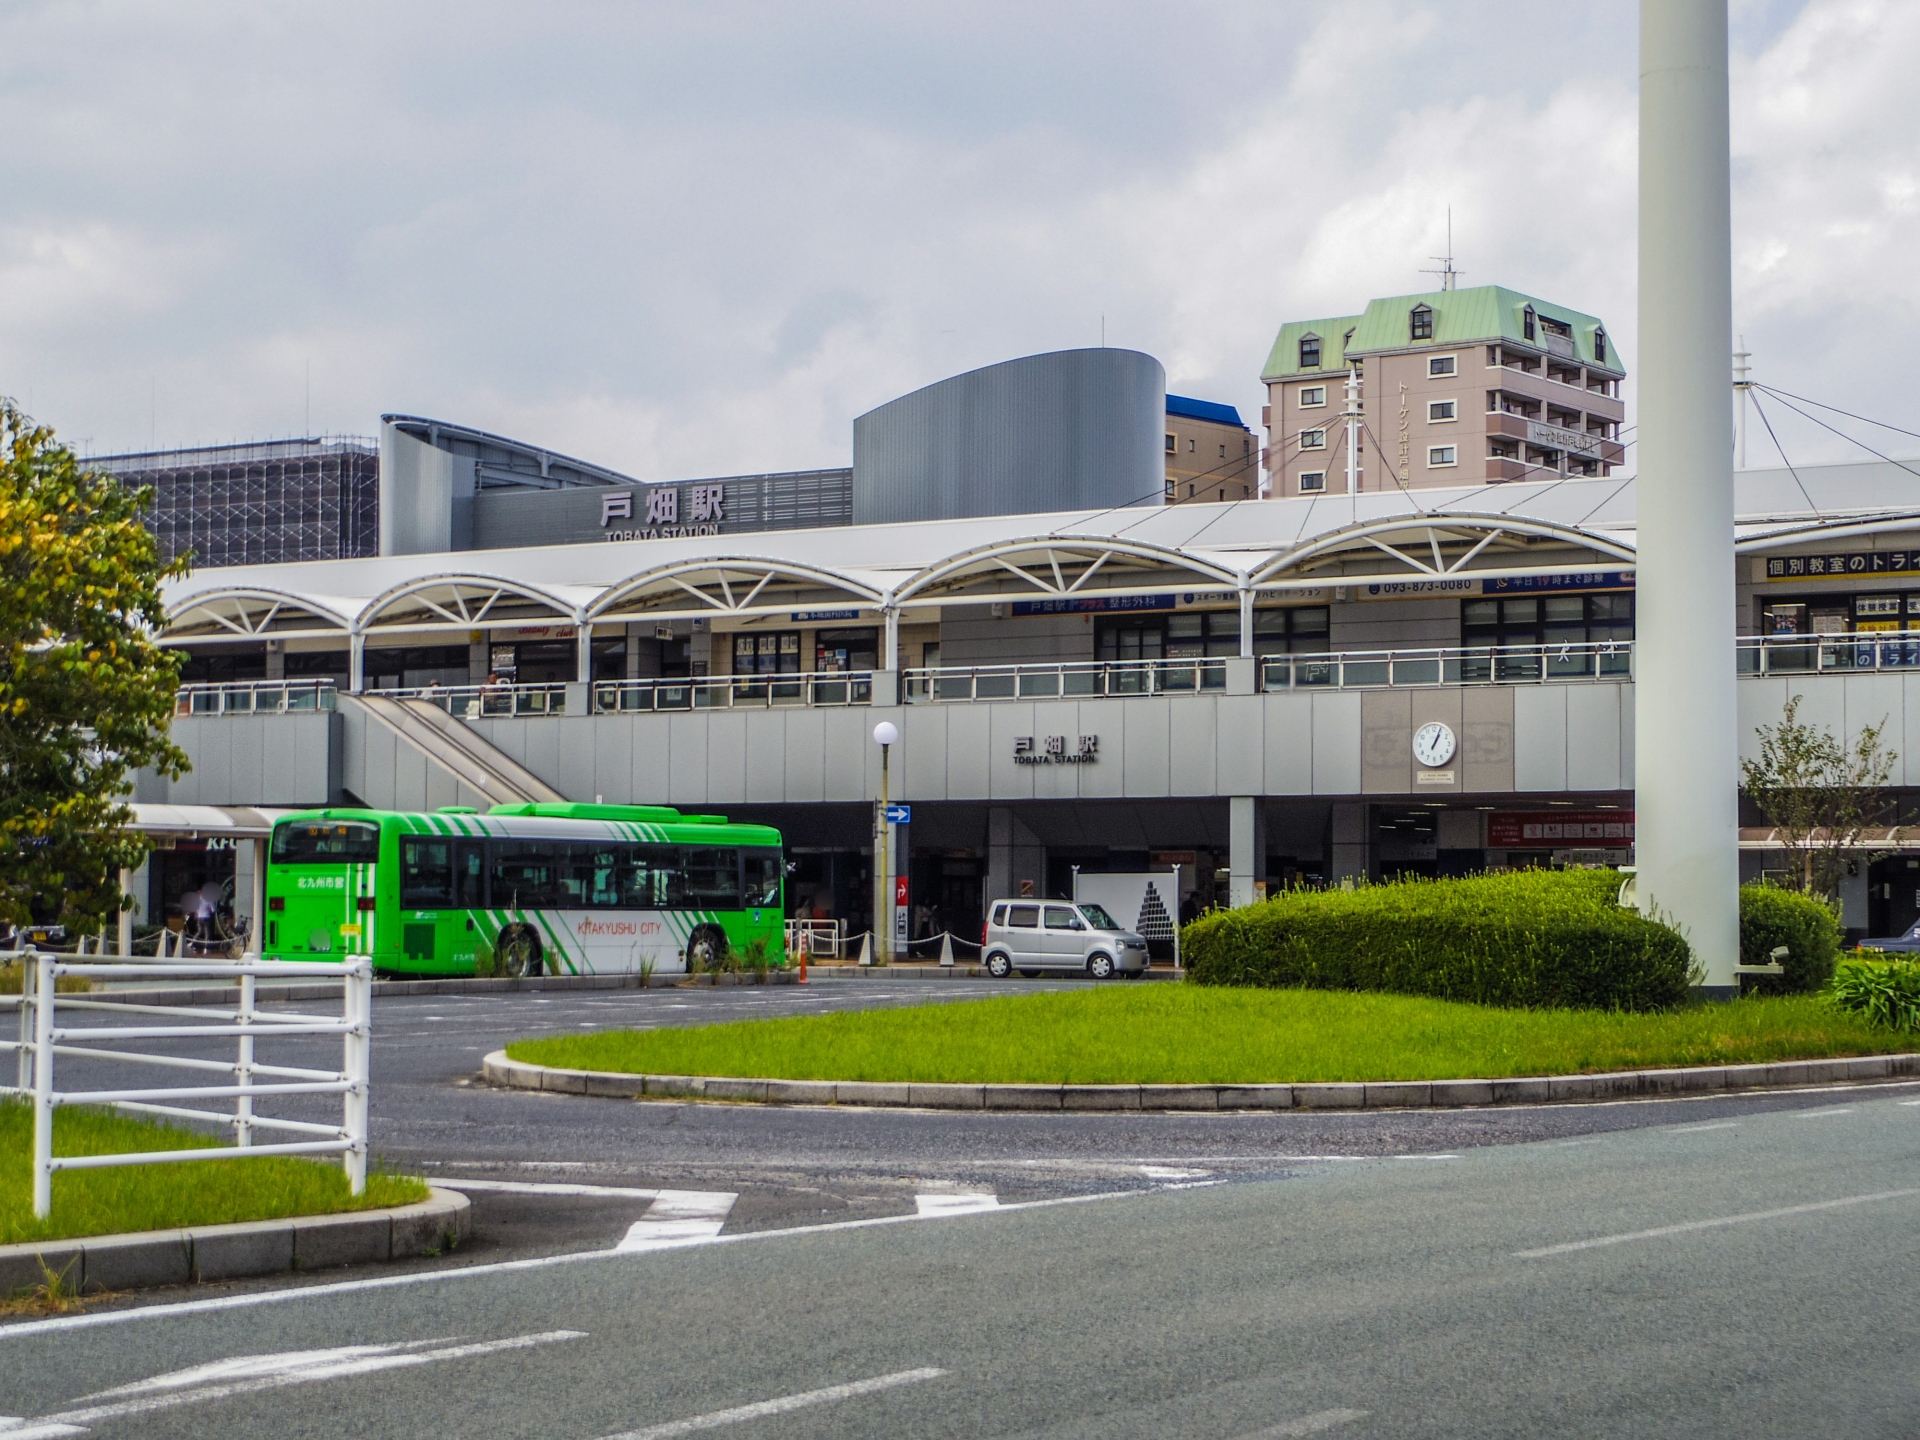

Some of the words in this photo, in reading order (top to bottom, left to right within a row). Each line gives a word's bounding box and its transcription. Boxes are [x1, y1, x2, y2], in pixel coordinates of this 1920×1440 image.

[601, 484, 723, 527] 戸畑駅
[605, 528, 658, 542] TOBATA
[662, 524, 718, 539] STATION
[1384, 579, 1471, 593] 093-873-0080
[1858, 653, 1918, 666] のライ
[1014, 735, 1098, 754] 戸畑駅
[1013, 755, 1050, 764] TOBATA
[1055, 754, 1096, 763] STATION
[298, 876, 345, 890] 北九州市営
[578, 922, 637, 935] KITAKYUSHU
[641, 922, 662, 935] CITY
